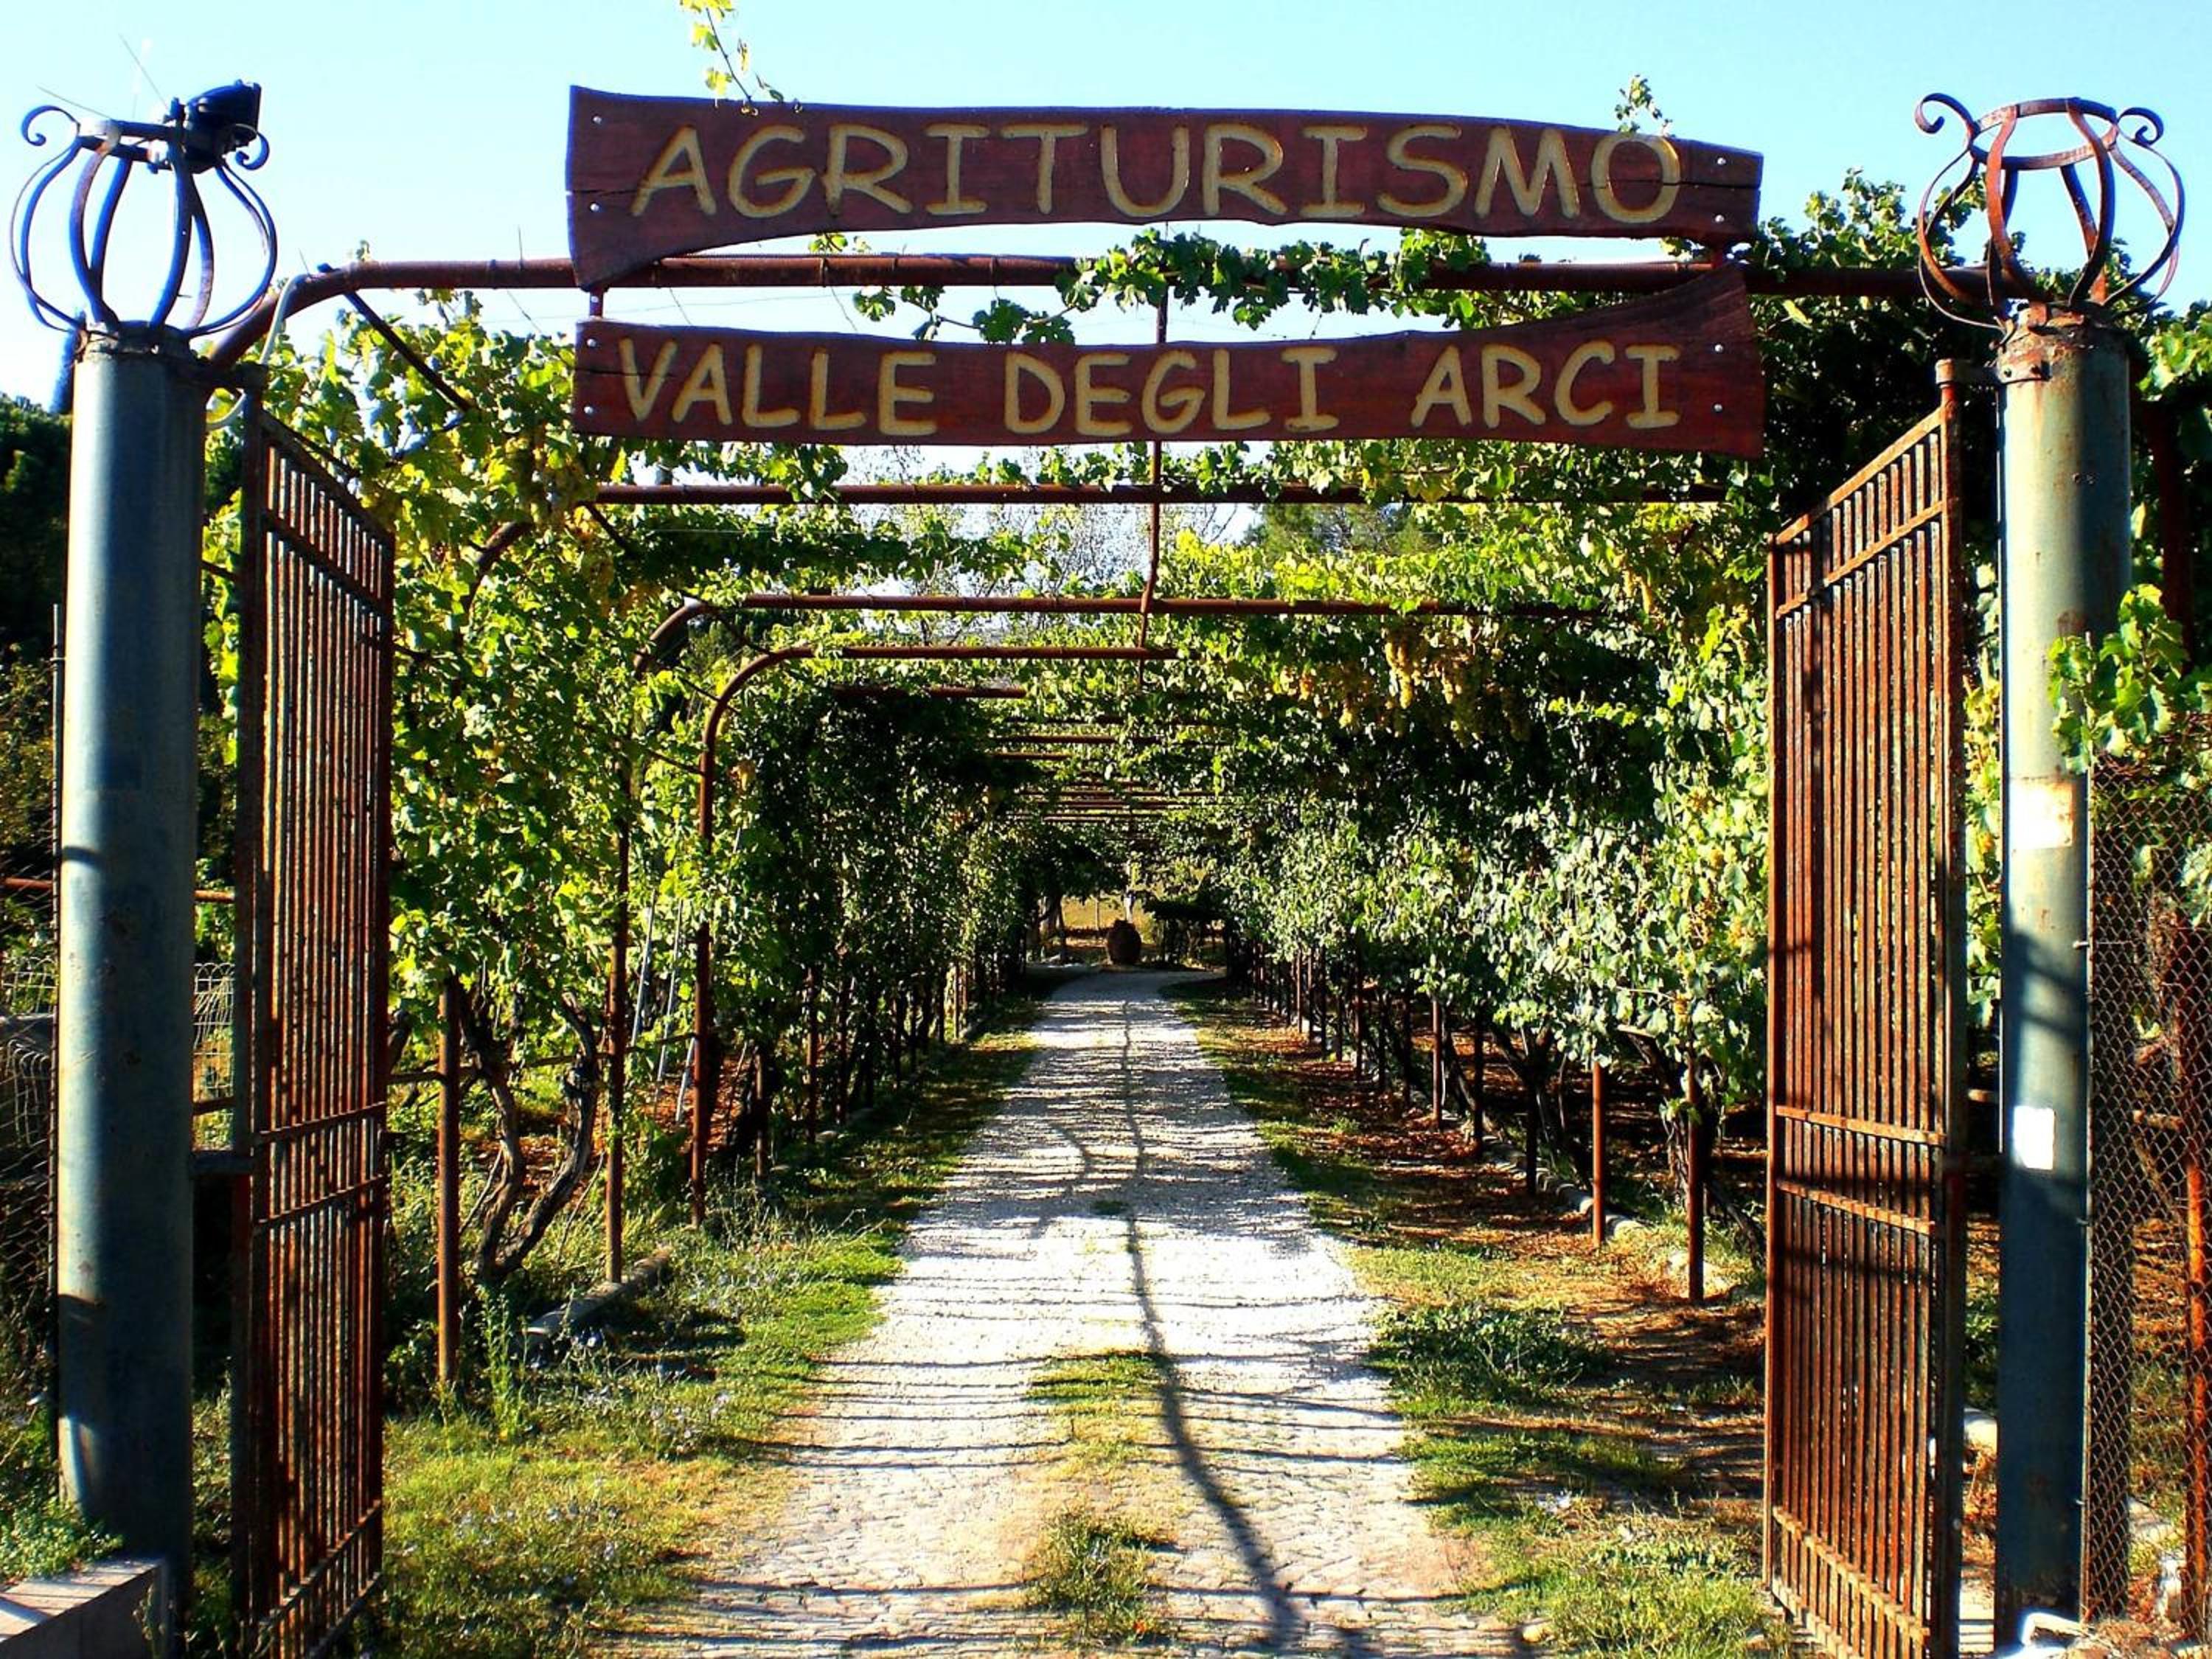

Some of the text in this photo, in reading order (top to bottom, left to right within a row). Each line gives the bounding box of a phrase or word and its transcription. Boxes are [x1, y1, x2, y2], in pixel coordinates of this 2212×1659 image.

[630, 122, 1681, 223] AGRITURISMO
[618, 337, 1681, 437] VALLE DEGLI ARCI
